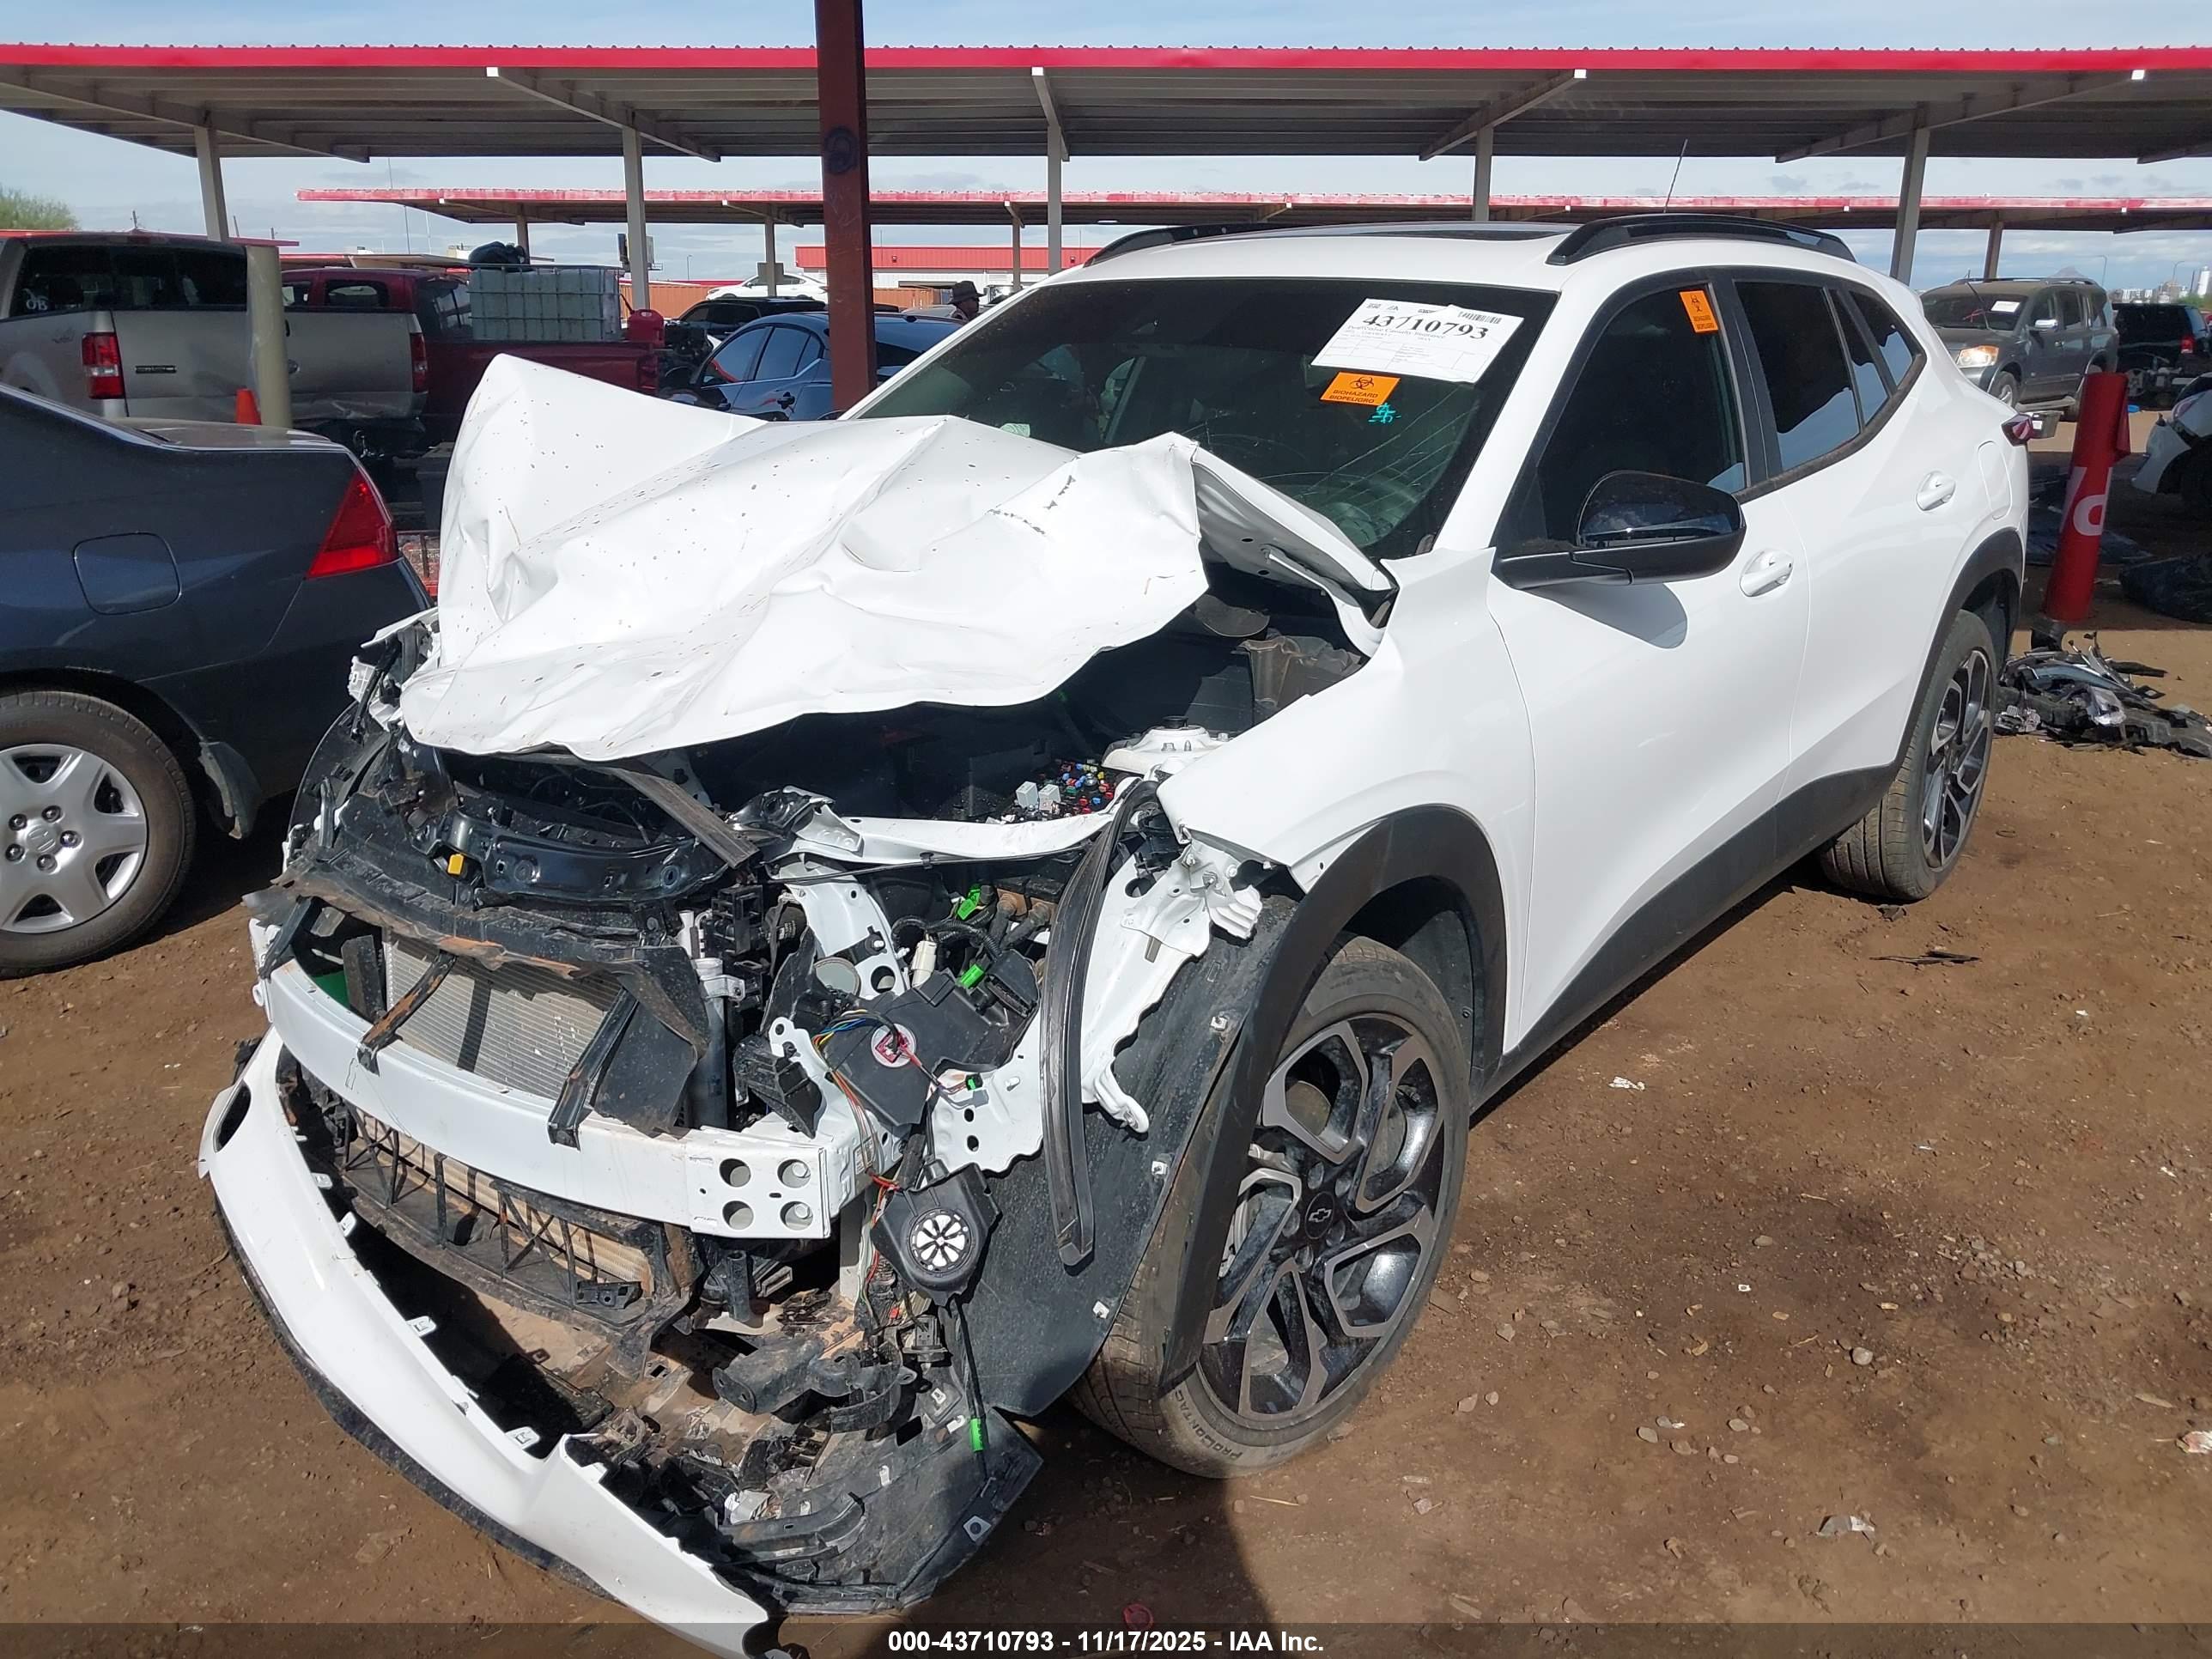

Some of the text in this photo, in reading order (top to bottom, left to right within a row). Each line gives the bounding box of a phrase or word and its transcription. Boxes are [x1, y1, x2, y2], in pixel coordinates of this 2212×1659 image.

[1362, 314, 1489, 339] 43710793
[1333, 389, 1379, 398] BIOHAZARD
[1328, 394, 1375, 404] BIOPELIGRO
